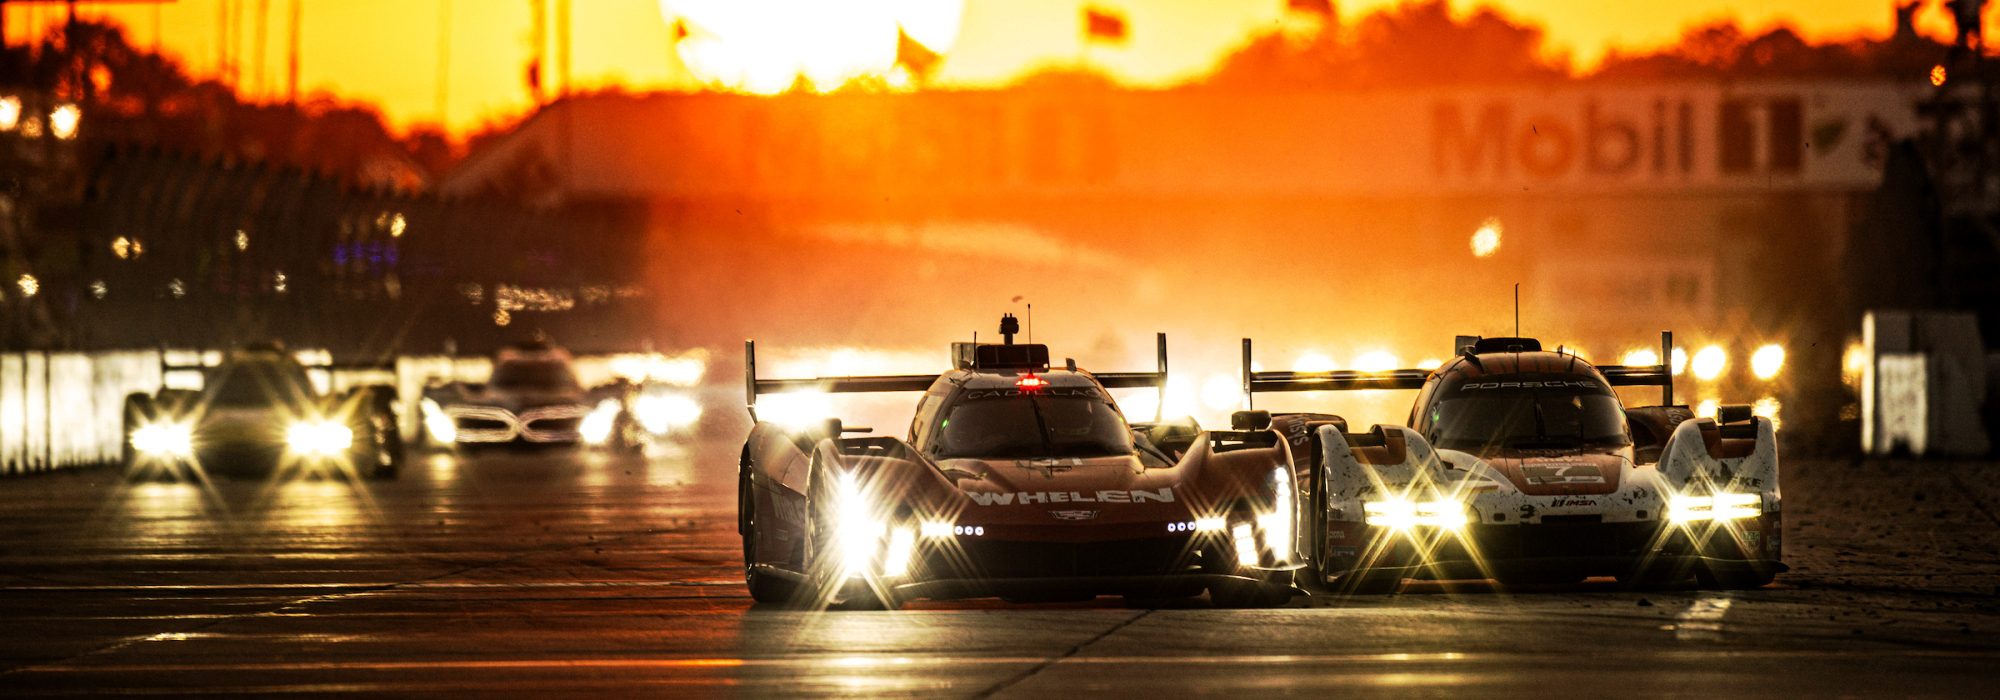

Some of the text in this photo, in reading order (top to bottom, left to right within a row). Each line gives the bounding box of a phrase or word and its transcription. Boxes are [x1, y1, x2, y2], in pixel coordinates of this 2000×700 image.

[1431, 99, 1694, 177] Mobil
[1460, 381, 1599, 391] PORSCHE
[967, 387, 1097, 399] CADILLAC
[1546, 464, 1573, 476] 7
[965, 487, 1176, 506] WHELEN
